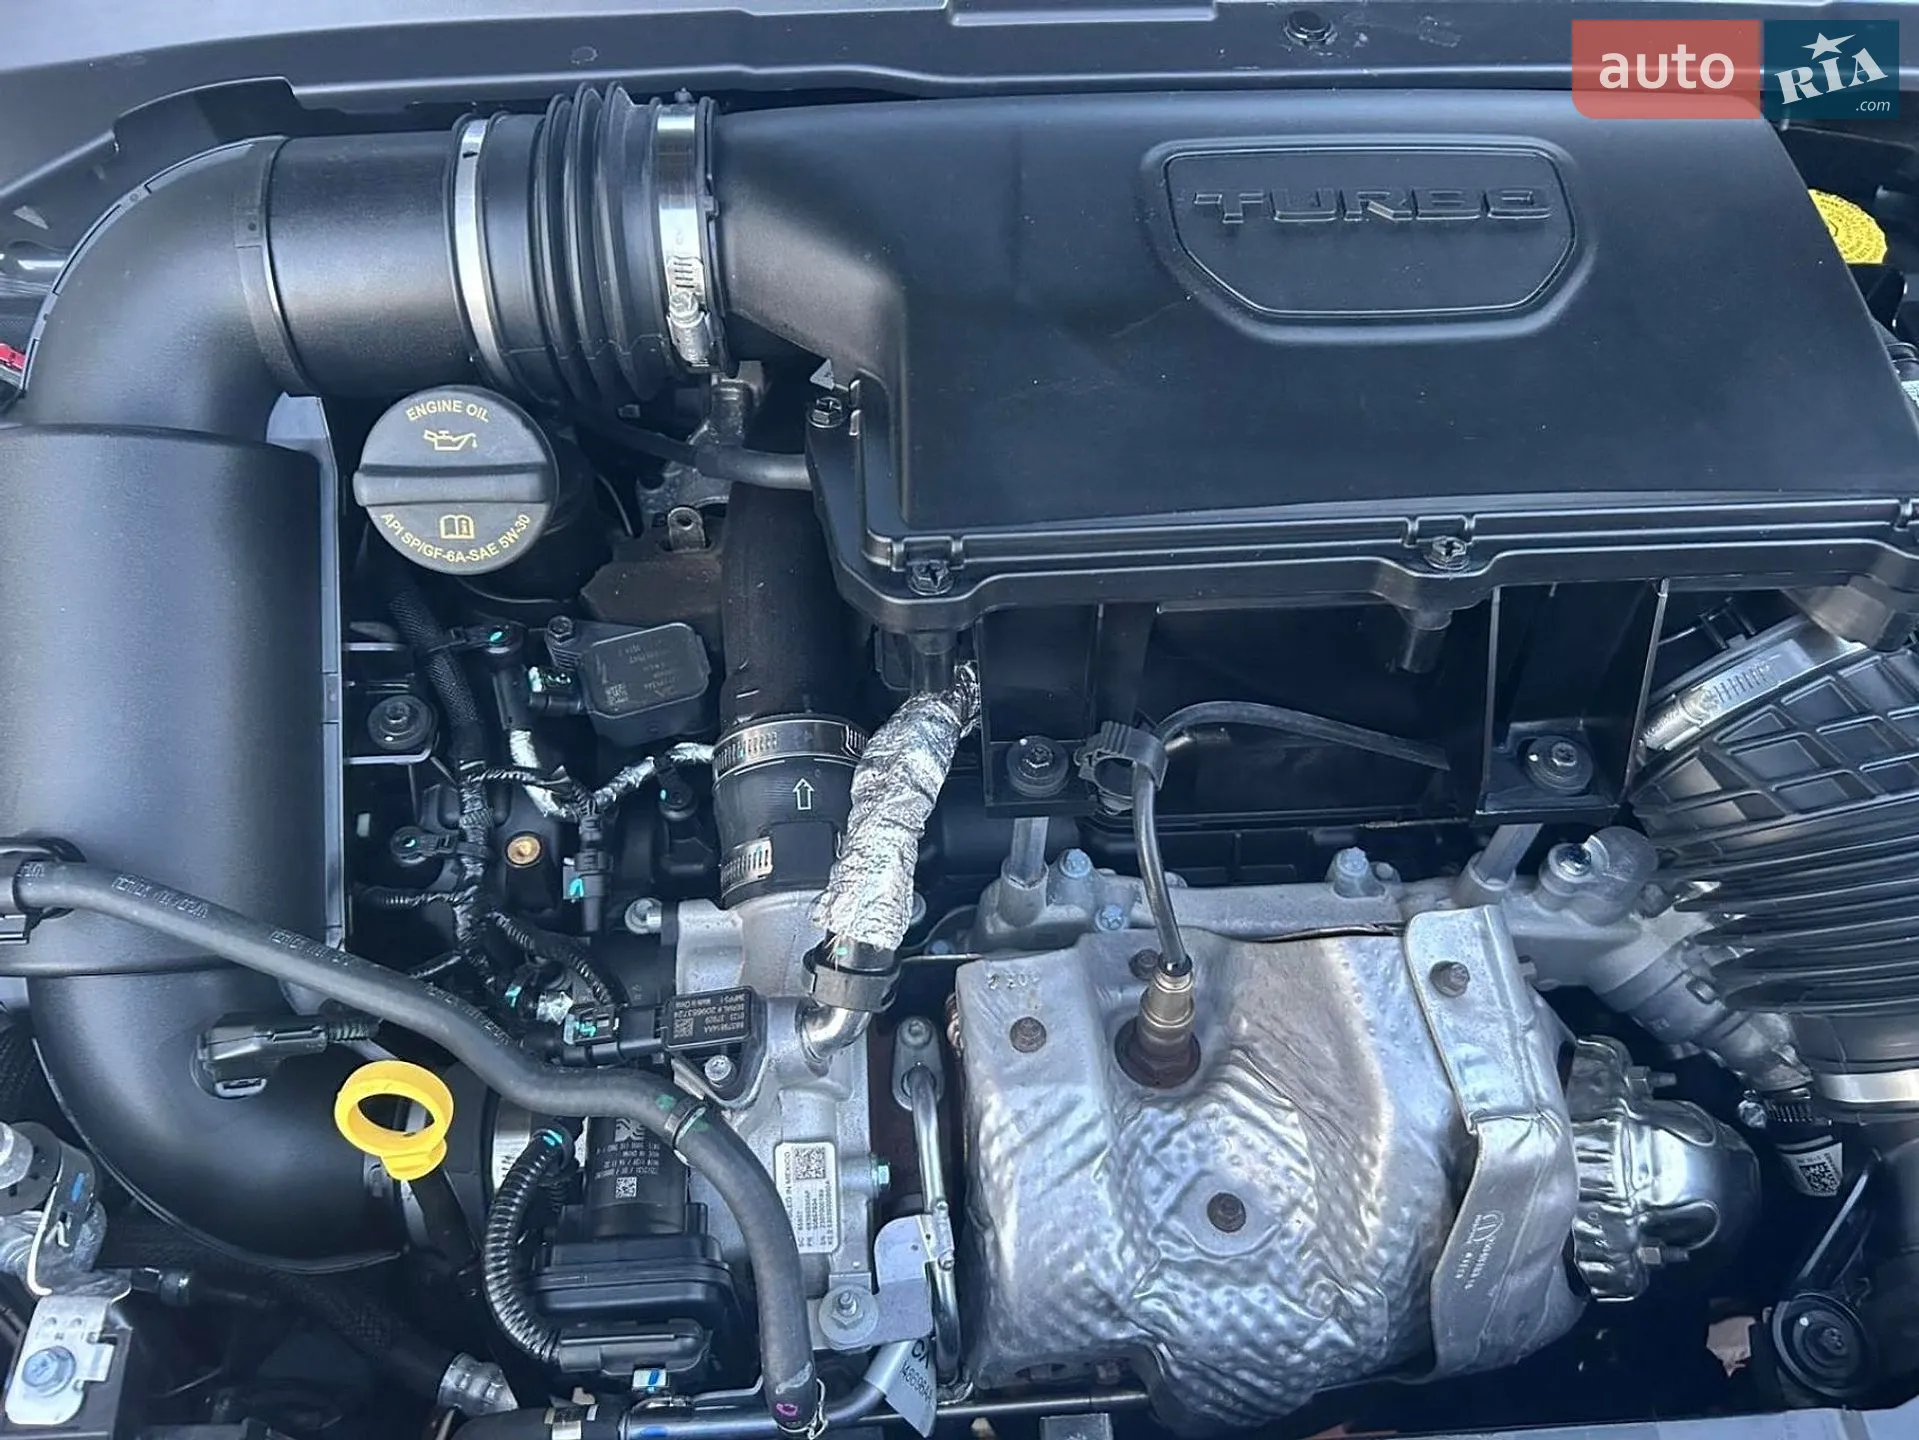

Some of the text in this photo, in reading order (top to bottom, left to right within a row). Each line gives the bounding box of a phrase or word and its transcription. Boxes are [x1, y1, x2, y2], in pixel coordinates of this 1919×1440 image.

[1194, 190, 1551, 224] TURBO
[405, 399, 491, 423] ENGINE OIL
[381, 512, 406, 537] API
[498, 513, 532, 549] 5W-30
[783, 1151, 792, 1185] MEXICO
